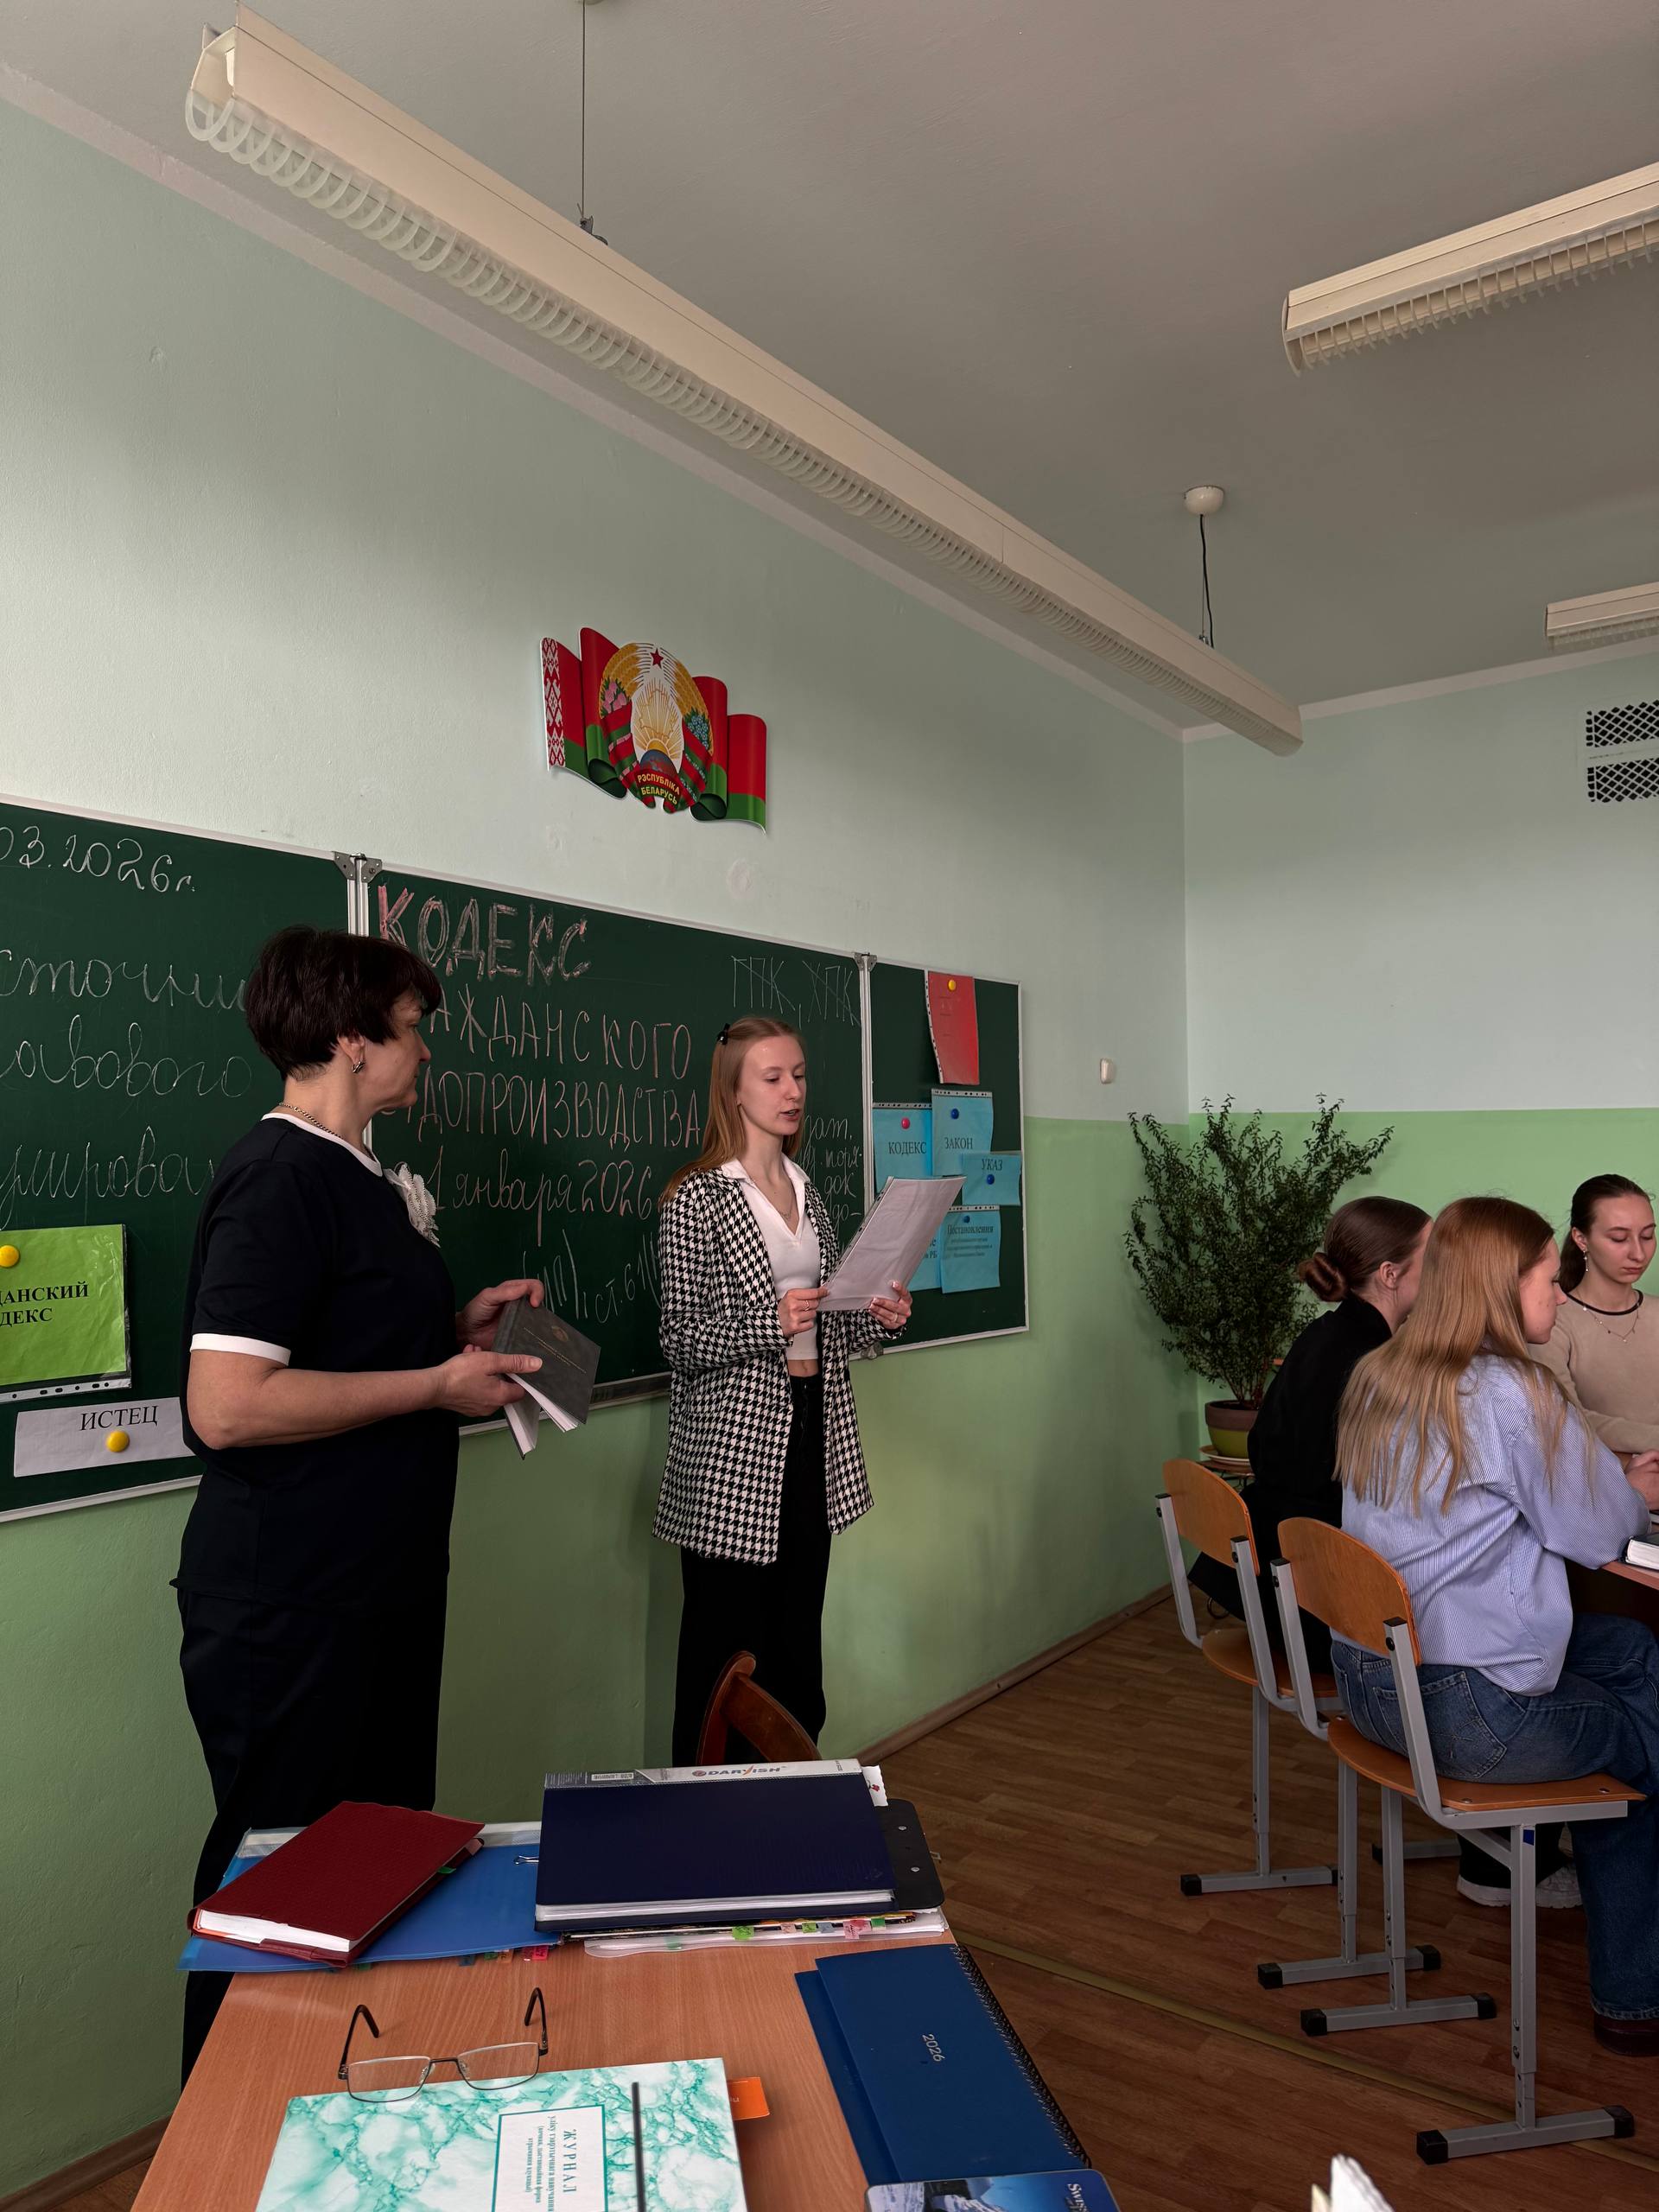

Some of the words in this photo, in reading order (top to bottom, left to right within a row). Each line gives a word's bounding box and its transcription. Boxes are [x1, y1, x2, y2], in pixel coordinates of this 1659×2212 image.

[638, 773, 680, 796] РЭСПУБЛІКА
[641, 786, 677, 805] БЕЛАРУСЬ
[378, 885, 591, 986] КОДЕКС
[381, 1064, 702, 1151] ДОПРОИЗВОДСТВА
[887, 1141, 927, 1156] КОДЕКС
[944, 1136, 974, 1150] ЗАКОН
[981, 1159, 1004, 1171] УКАЗ
[452, 1147, 576, 1248] января
[578, 1160, 652, 1220] 2026
[0, 1281, 89, 1305] АНСКИЙ
[0, 1307, 53, 1328] ДЕКС
[79, 1406, 159, 1431] ИСТЕЦ
[921, 2033, 945, 2063] 2026
[563, 2128, 577, 2194] ЖУРНАЛ
